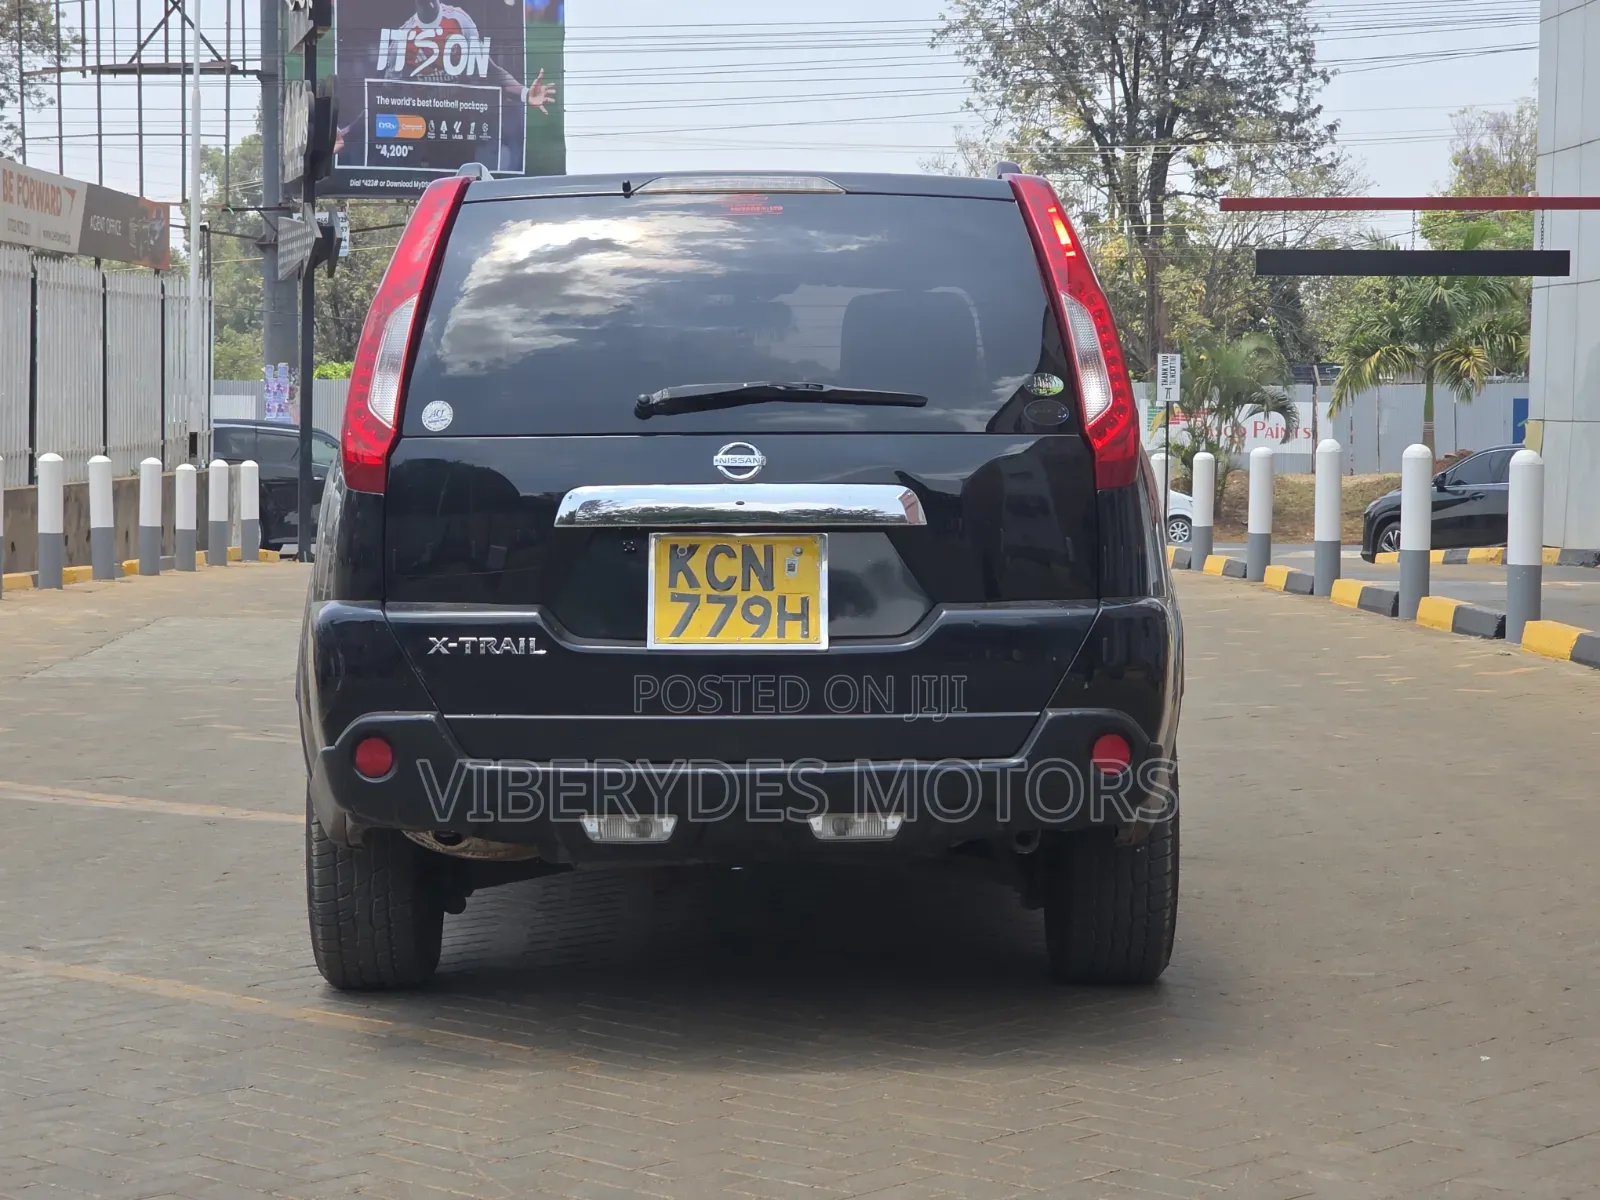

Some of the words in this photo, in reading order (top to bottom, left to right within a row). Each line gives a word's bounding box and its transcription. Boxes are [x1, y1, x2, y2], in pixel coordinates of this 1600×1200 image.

[377, 27, 443, 77] IT'S
[443, 34, 491, 78] ON
[376, 95, 389, 105] The
[390, 96, 416, 106] world's
[416, 97, 432, 107] best
[433, 98, 458, 109] football
[459, 101, 488, 112] package
[2, 168, 14, 205] BE
[16, 172, 62, 217] FORWARD
[349, 178, 361, 187] Dial
[386, 180, 413, 189] Download
[89, 214, 105, 232] AGENT
[106, 217, 122, 236] OFFICE
[1161, 355, 1169, 367] YOU
[1161, 367, 1169, 386] THANK
[668, 543, 775, 592] KCN
[669, 592, 810, 639] 779H
[427, 637, 547, 654] X-TRAIL
